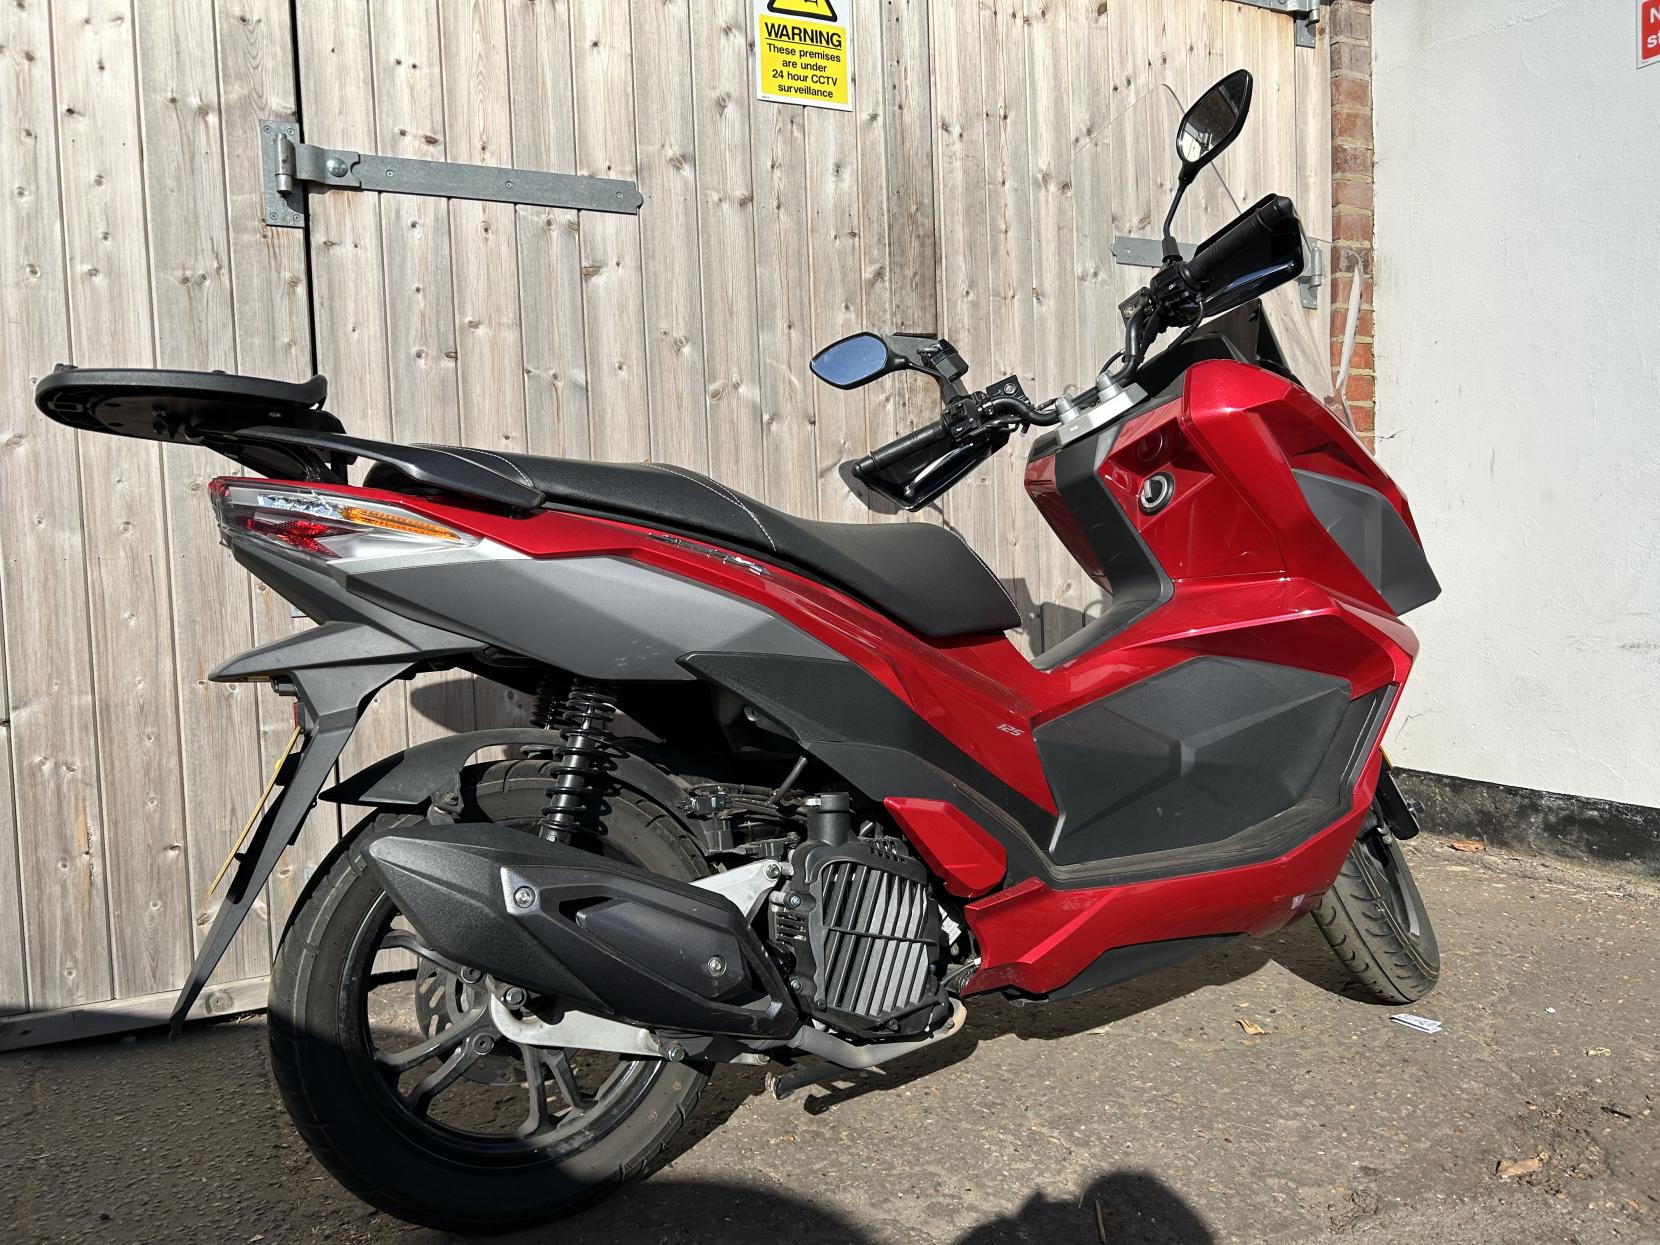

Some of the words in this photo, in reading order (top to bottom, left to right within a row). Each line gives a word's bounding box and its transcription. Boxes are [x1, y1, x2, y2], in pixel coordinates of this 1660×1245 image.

[765, 22, 842, 48] WARNING
[767, 43, 796, 55] These
[799, 49, 841, 62] premises
[782, 60, 797, 68] are
[800, 61, 827, 72] under
[772, 69, 784, 79] 24
[787, 71, 809, 82] hour
[811, 74, 838, 86] CCTV
[778, 84, 833, 98] surveillance
[996, 724, 1025, 736] 125
